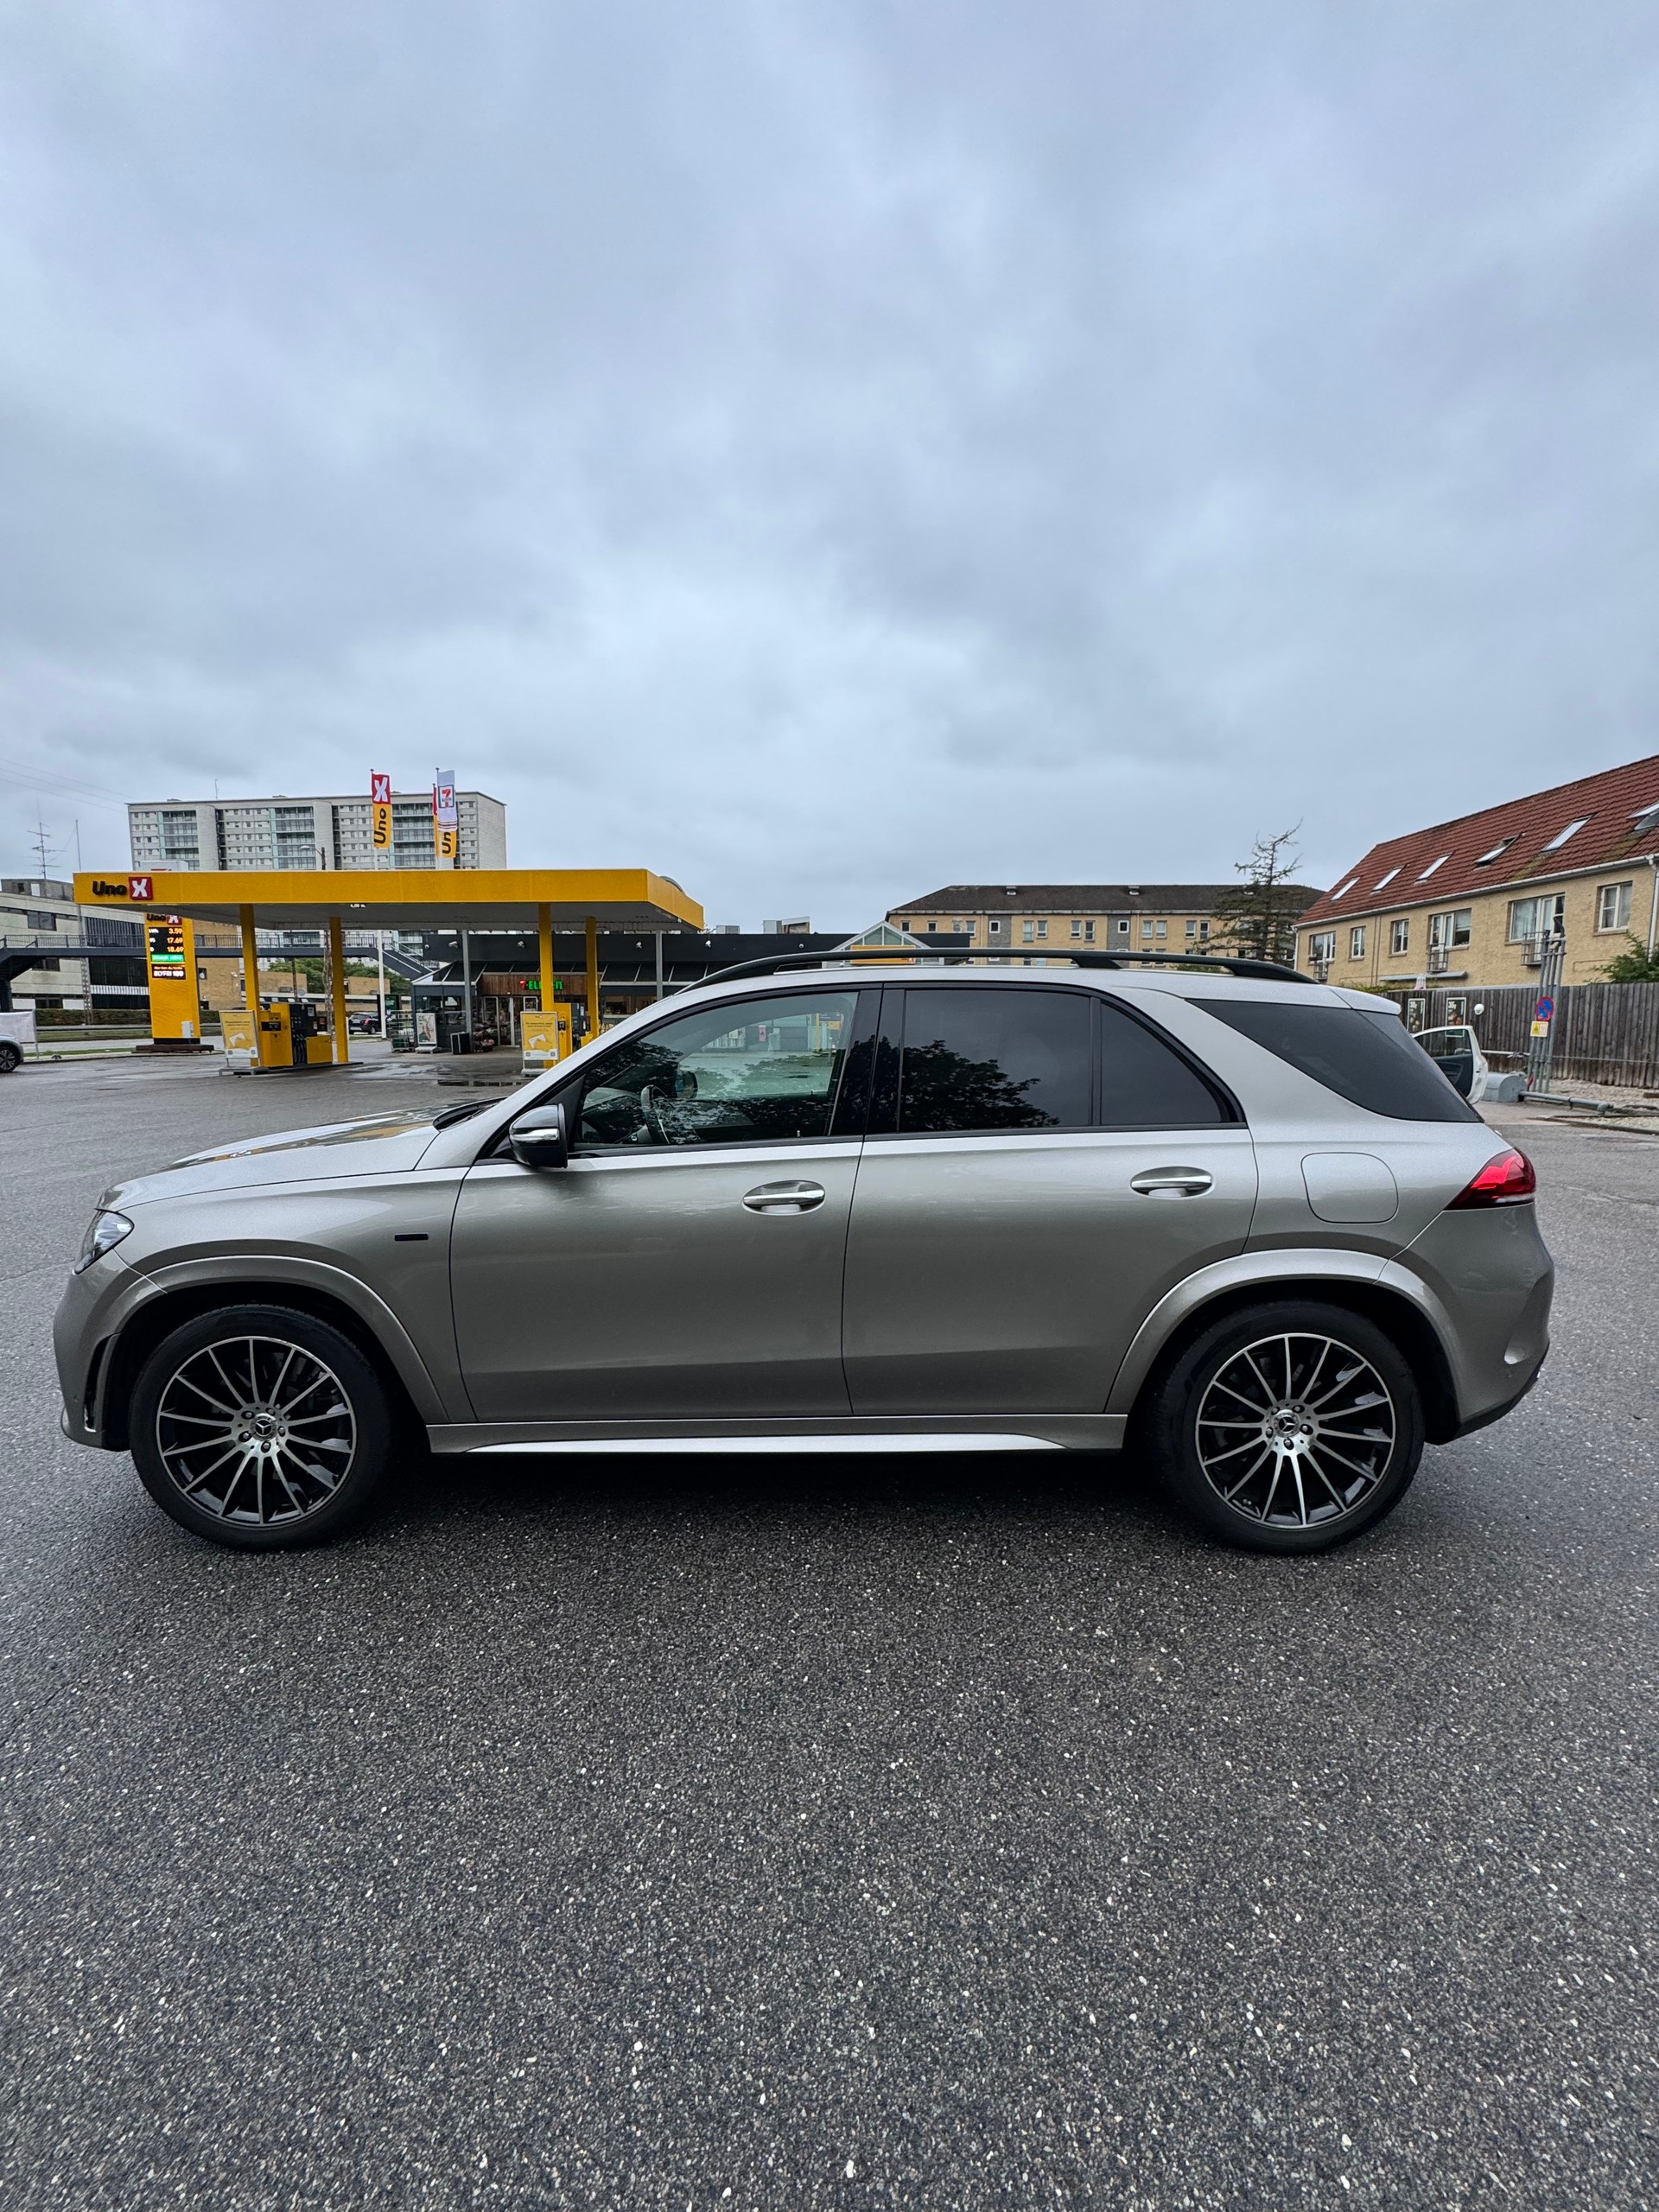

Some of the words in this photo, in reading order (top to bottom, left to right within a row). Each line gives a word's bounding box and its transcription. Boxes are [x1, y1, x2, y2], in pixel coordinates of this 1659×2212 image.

[373, 777, 388, 802] X
[374, 808, 387, 845] Uno
[442, 832, 452, 855] Un
[92, 881, 128, 896] Uno
[131, 879, 148, 898] X
